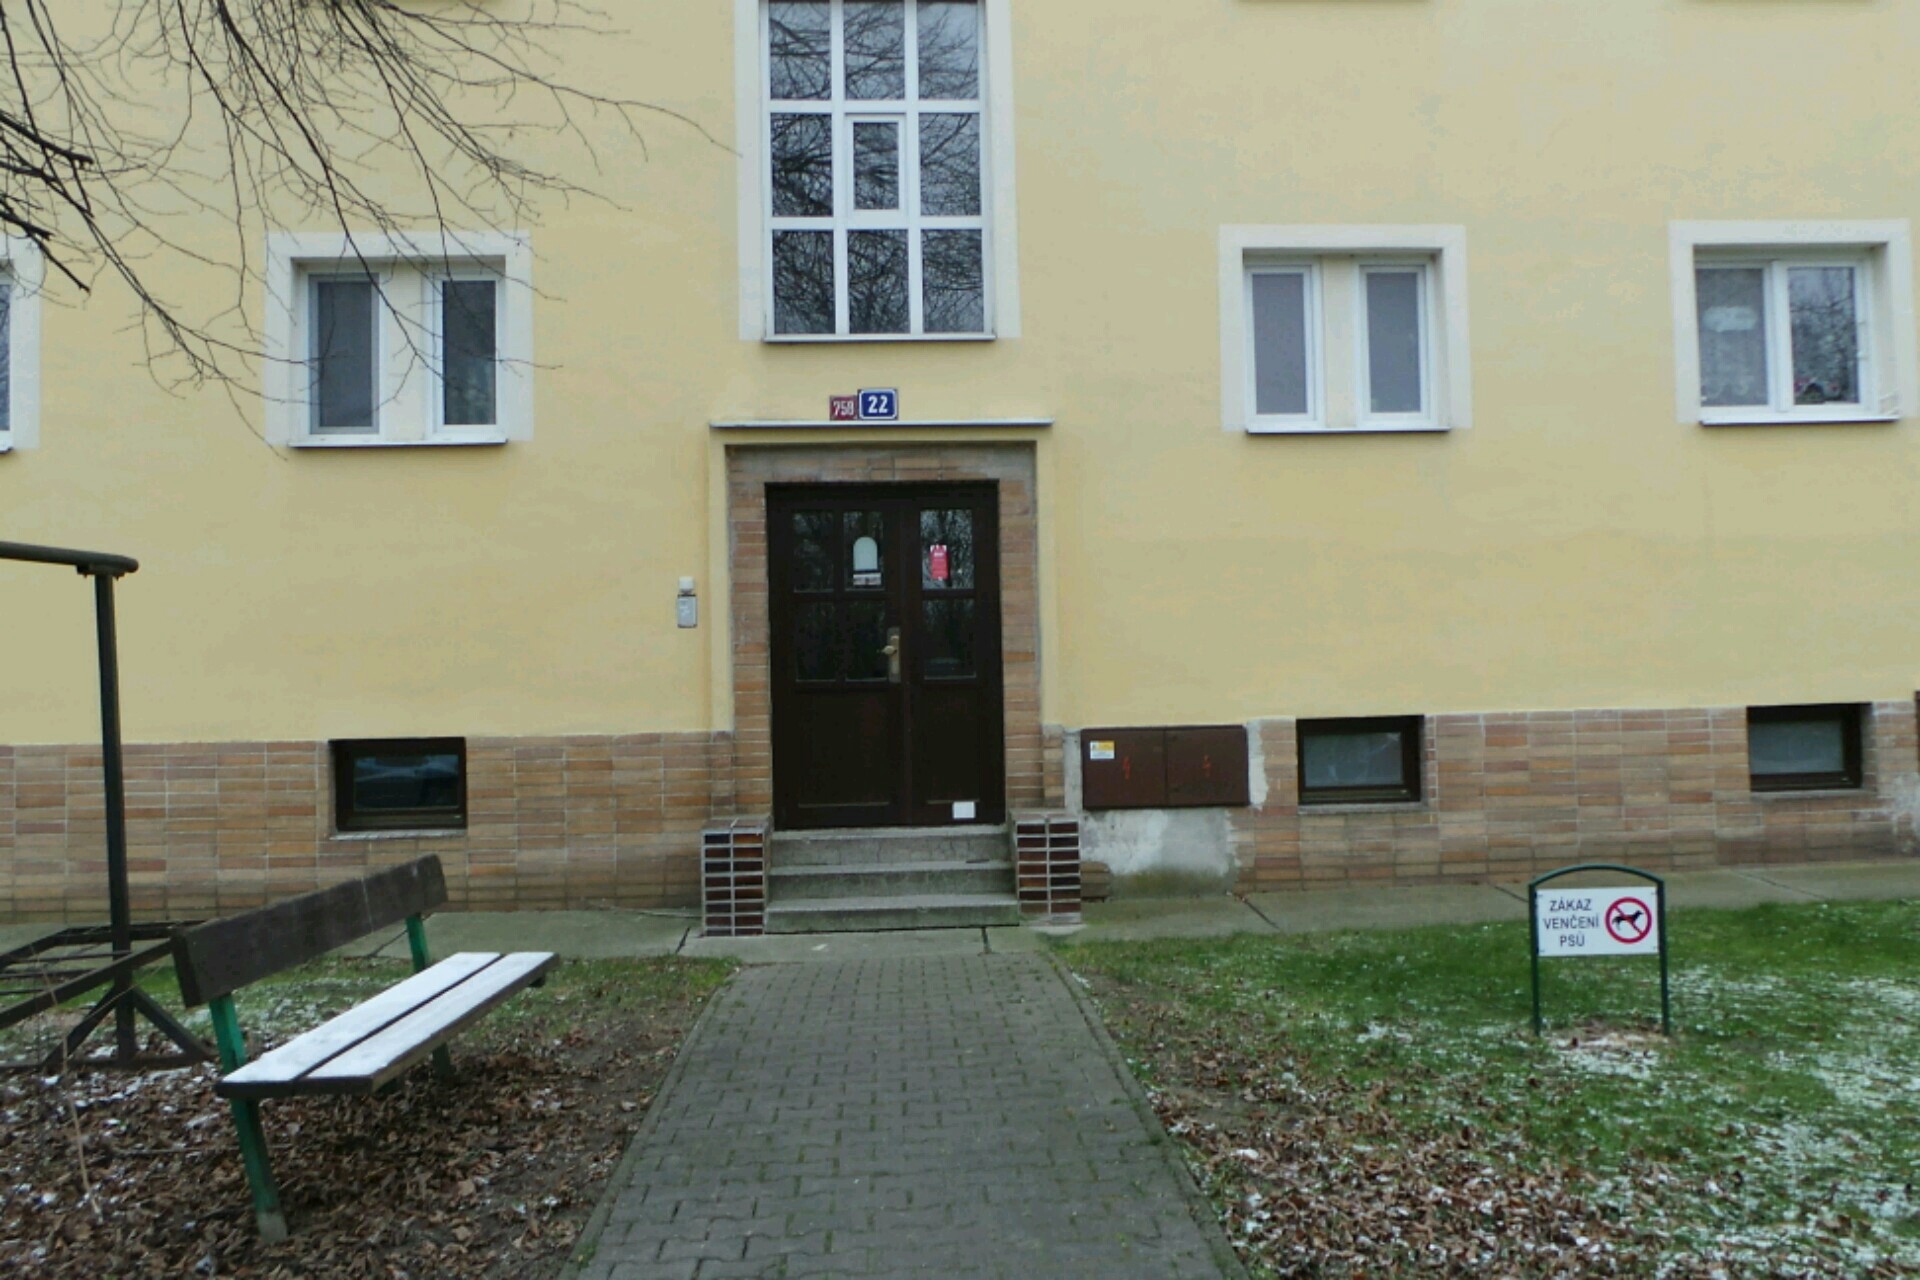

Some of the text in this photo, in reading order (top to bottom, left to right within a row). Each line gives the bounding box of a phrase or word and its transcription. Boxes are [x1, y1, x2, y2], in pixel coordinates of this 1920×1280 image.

[868, 395, 888, 414] 22
[1550, 897, 1592, 911] ZÁKAZ
[1543, 914, 1599, 929] VENČENÍ
